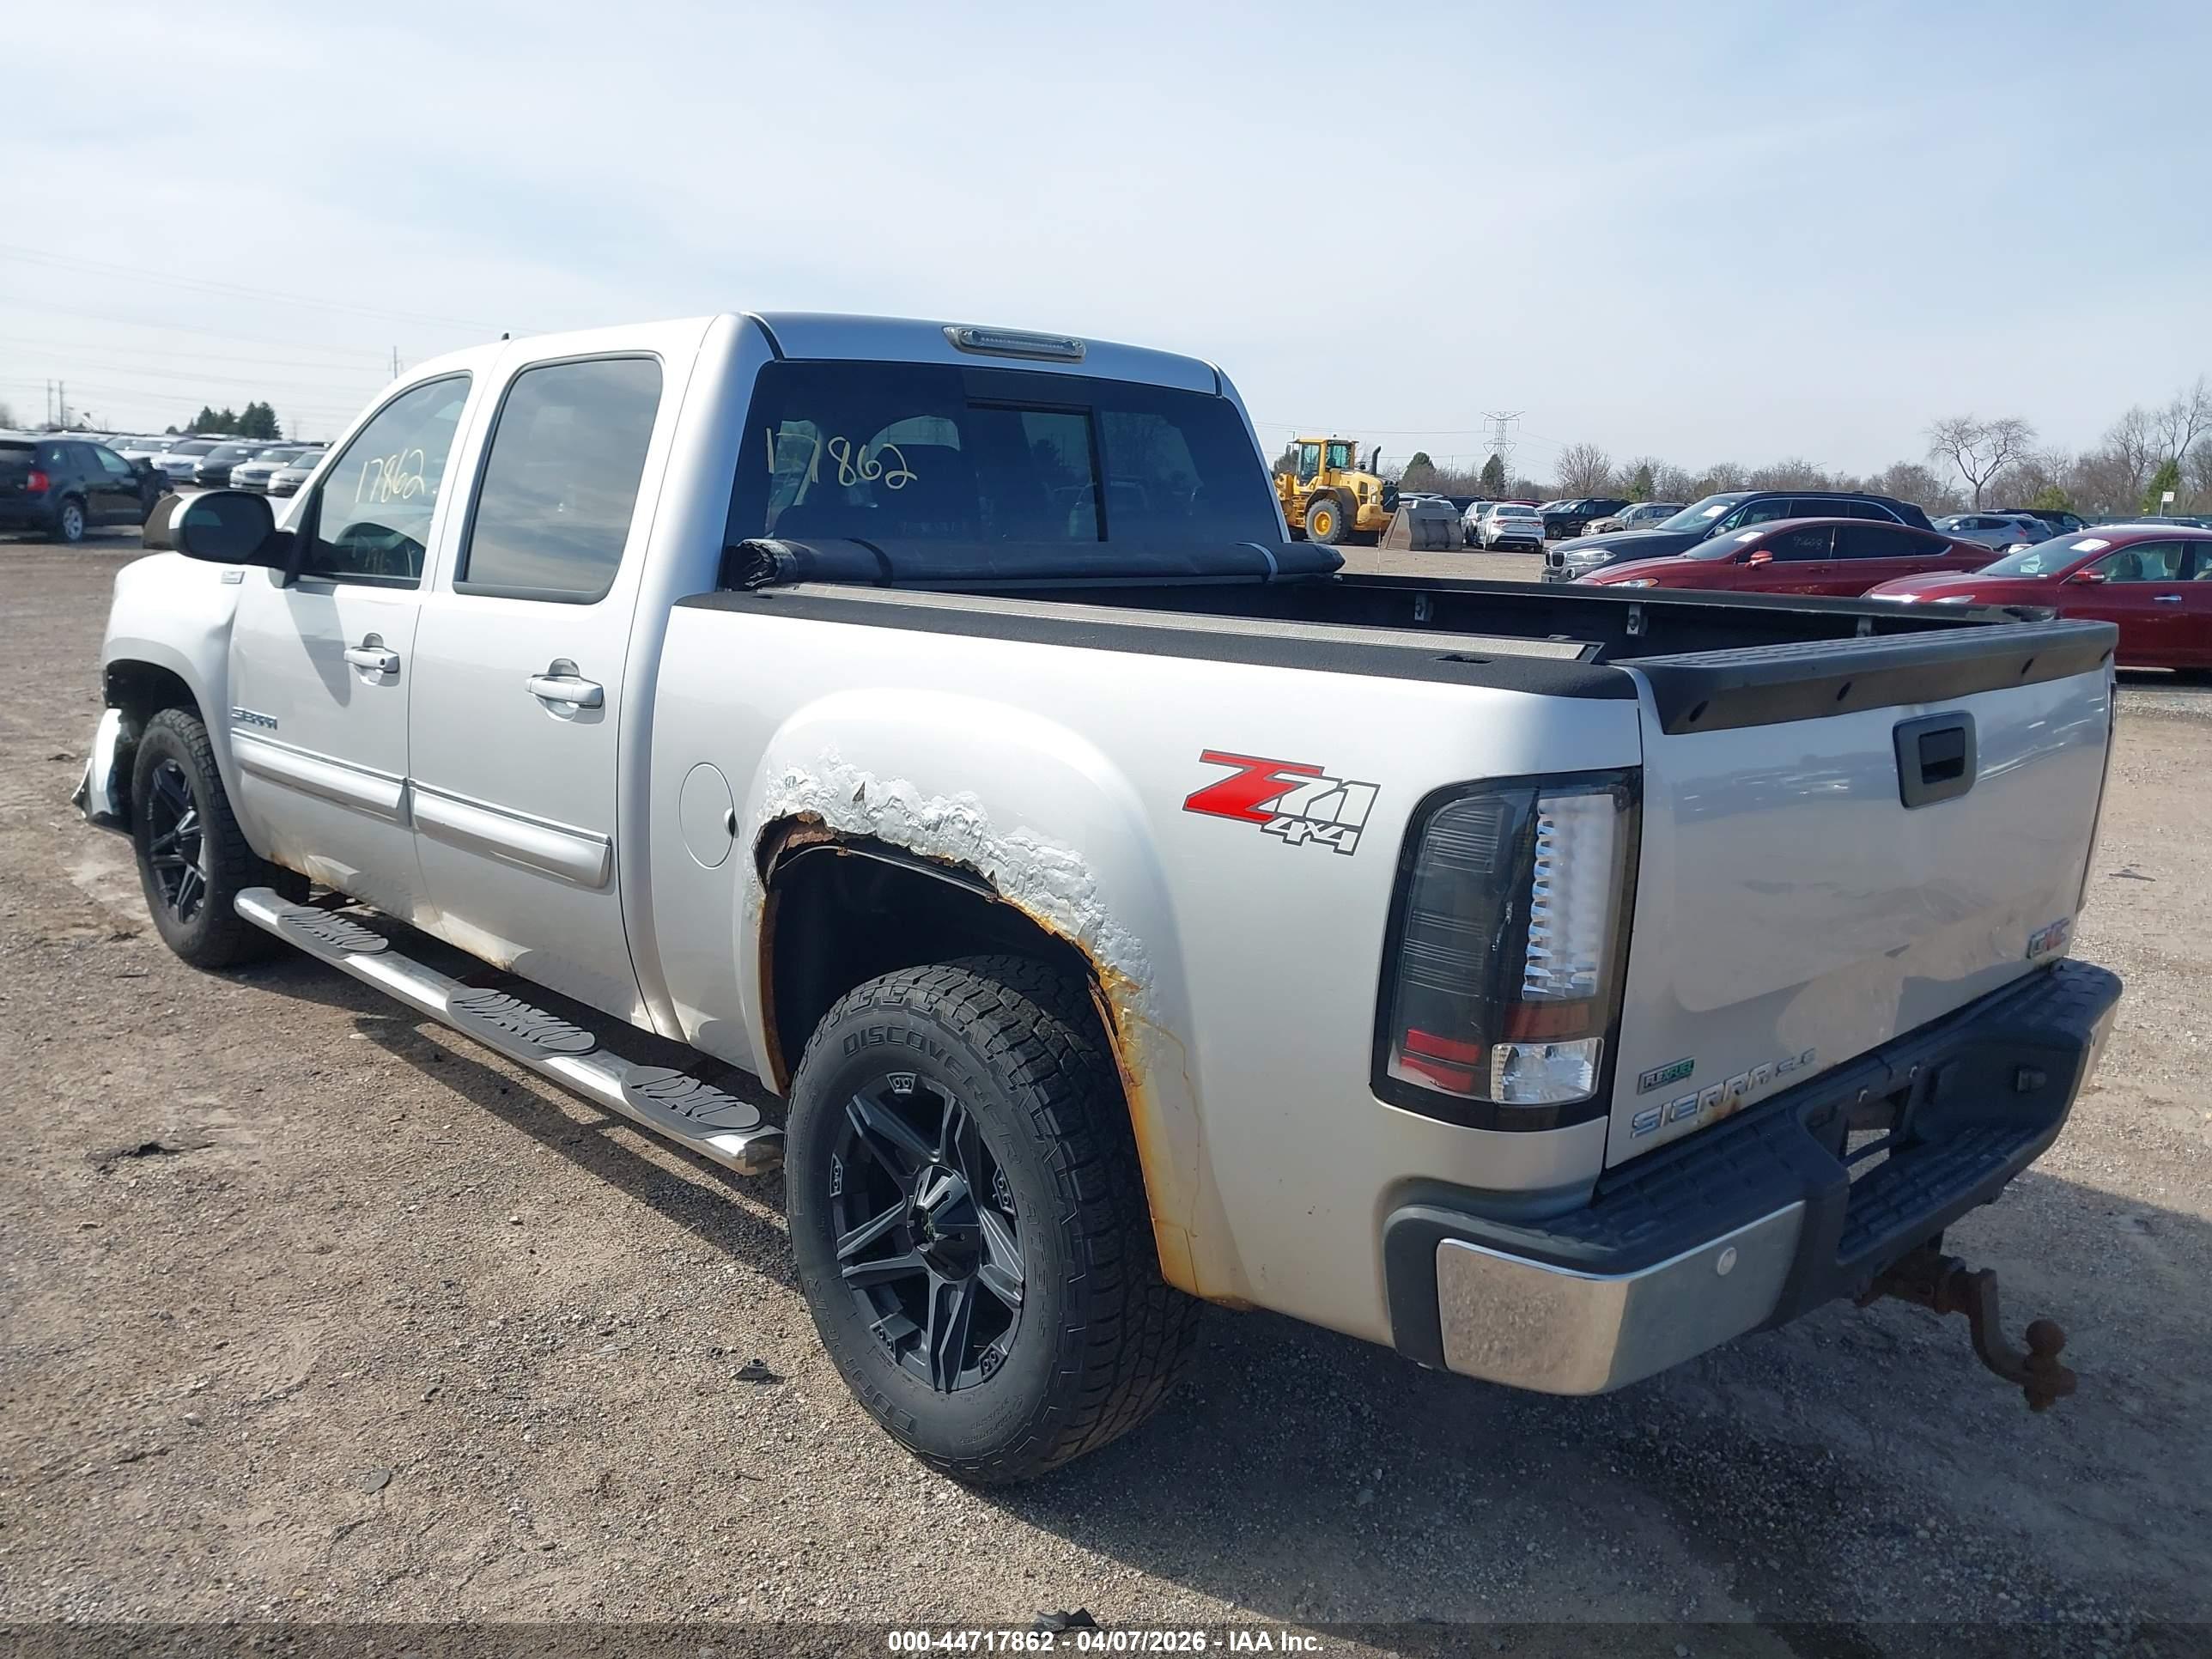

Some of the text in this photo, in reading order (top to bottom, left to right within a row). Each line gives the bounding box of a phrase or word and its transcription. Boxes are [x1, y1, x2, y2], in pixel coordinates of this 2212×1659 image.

[355, 447, 425, 503] 17862
[765, 428, 918, 506] 17862
[1182, 749, 1381, 829] Z71
[2027, 917, 2070, 959] GMC
[1630, 1061, 1773, 1140] SIERRA
[1643, 1058, 1696, 1090] FLEXFUEL
